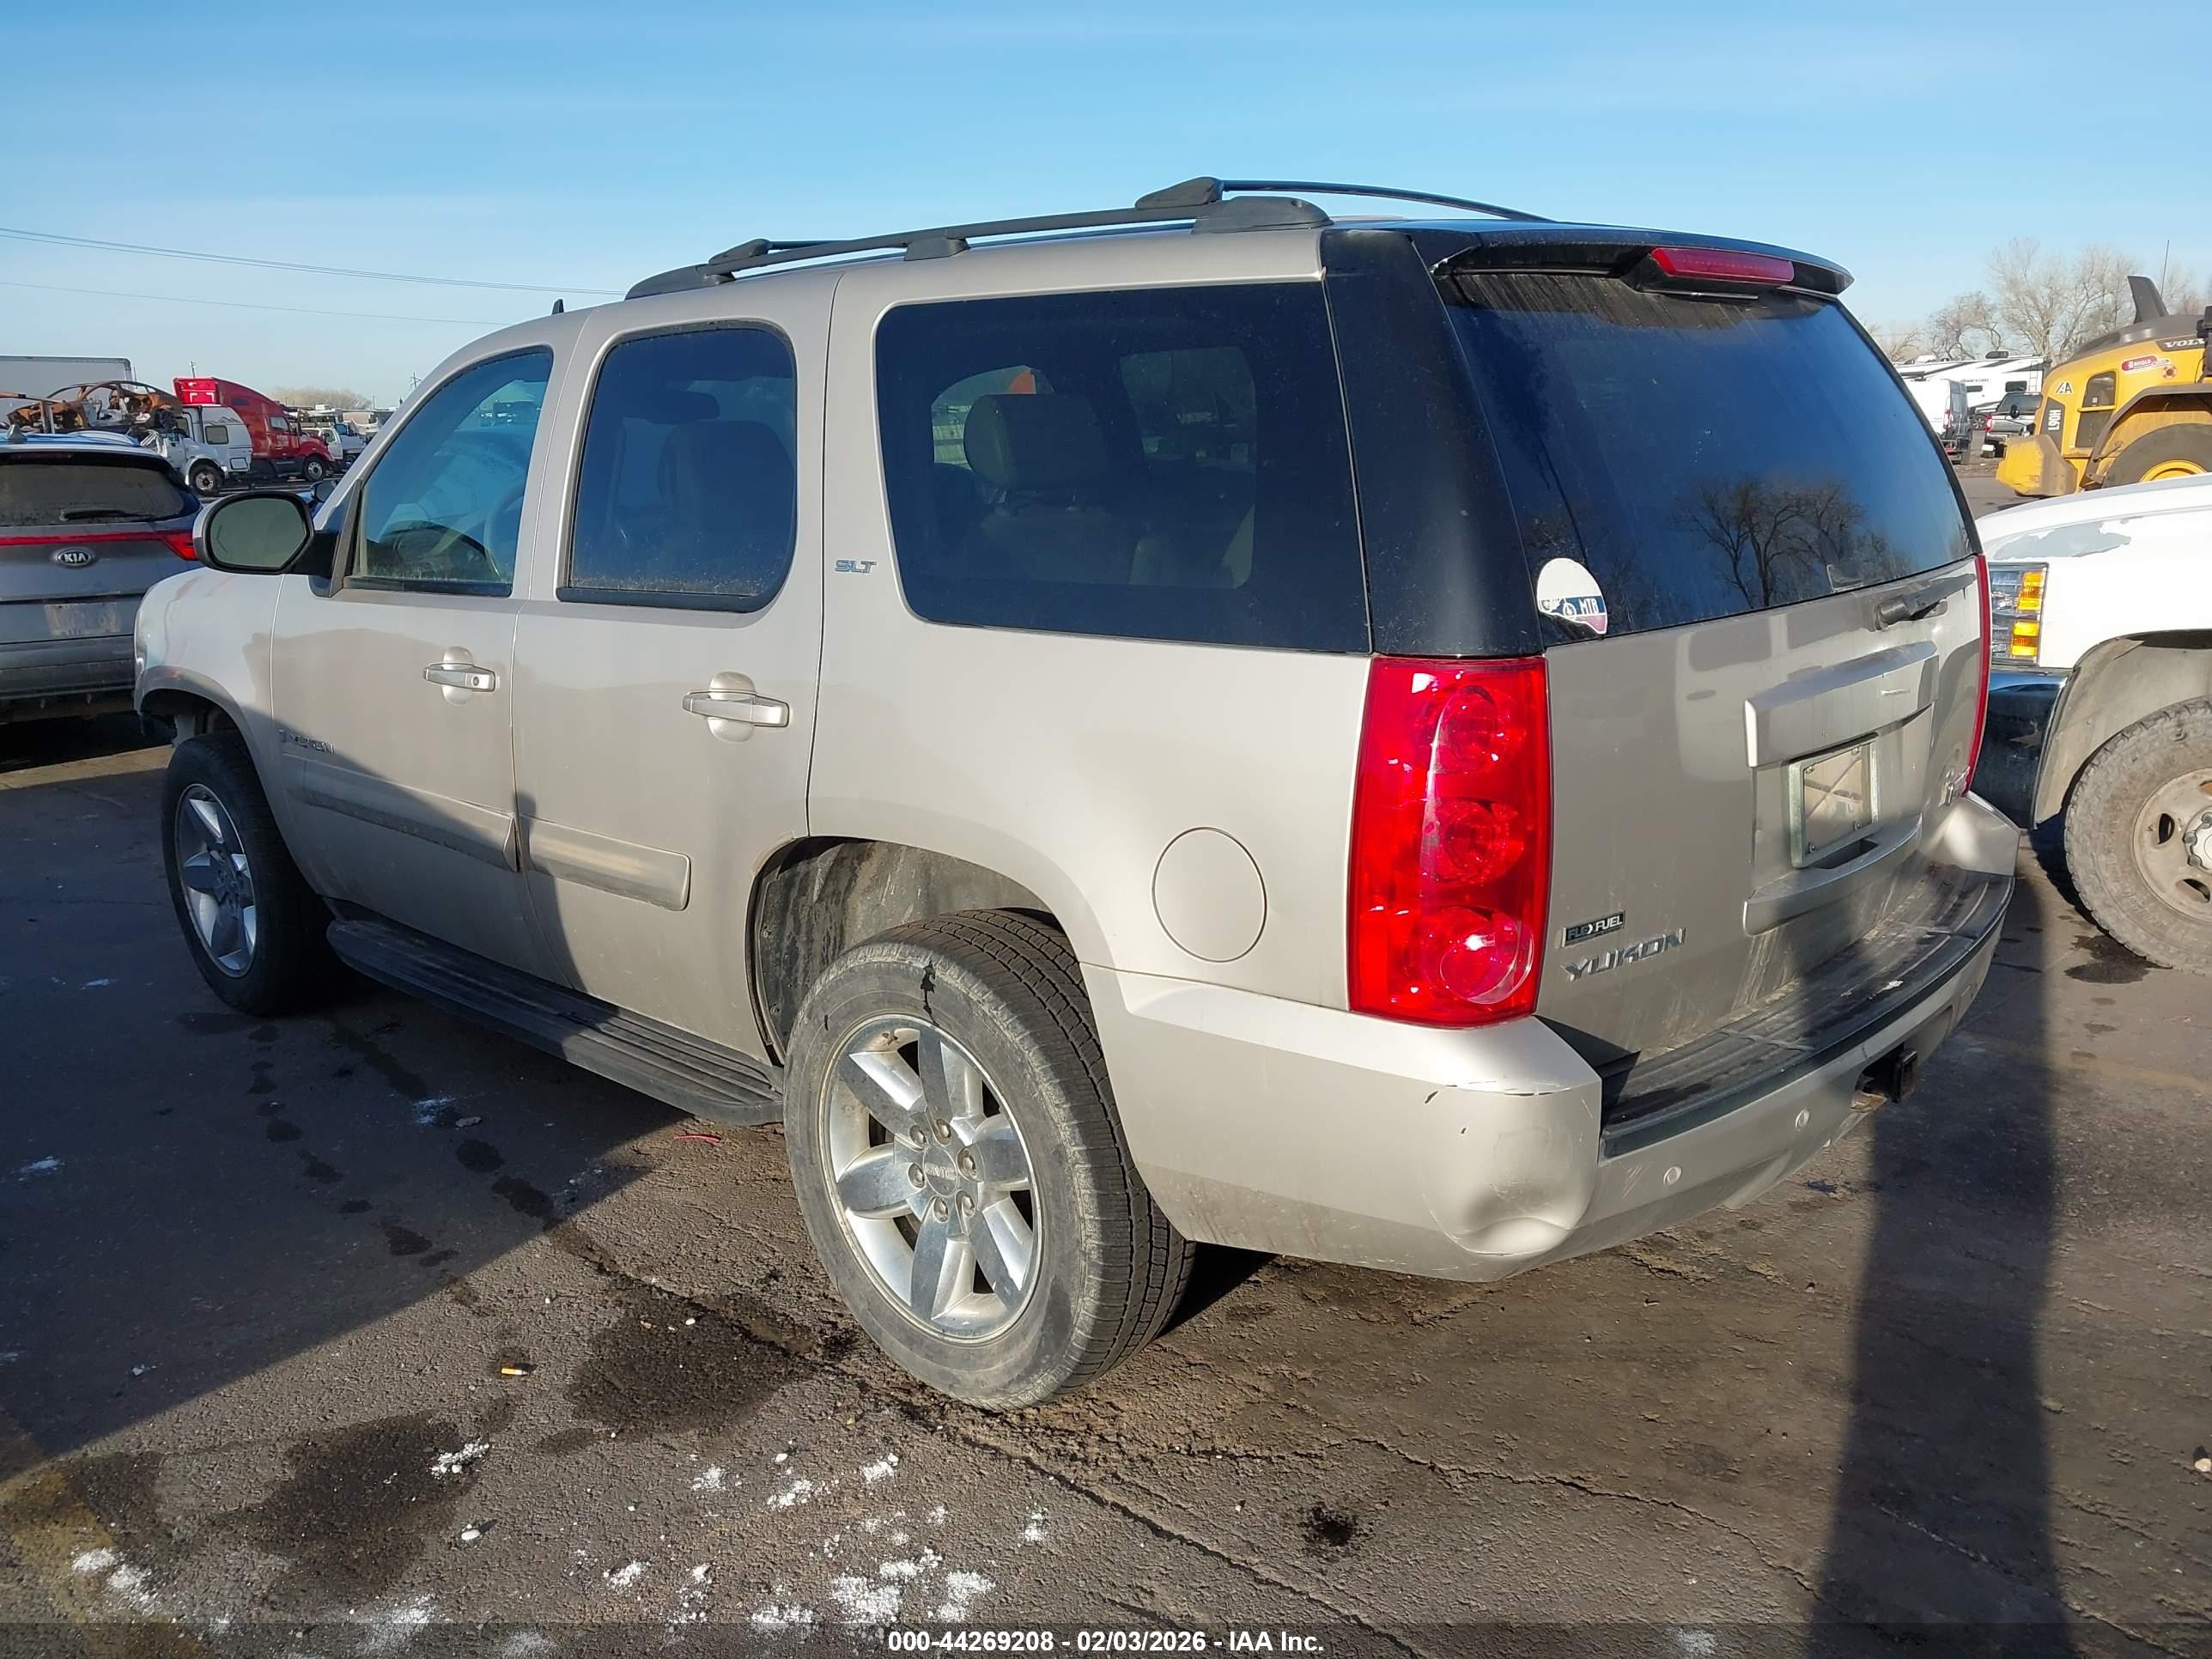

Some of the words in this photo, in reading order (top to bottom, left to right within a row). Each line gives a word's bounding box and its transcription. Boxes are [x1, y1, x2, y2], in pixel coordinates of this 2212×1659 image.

[2164, 338, 2205, 348] VOLV
[2047, 410, 2062, 431] L90H
[64, 553, 86, 563] KIA
[835, 559, 878, 574] SLT
[1560, 927, 1686, 982] YUKON
[925, 1163, 957, 1181] GMC
